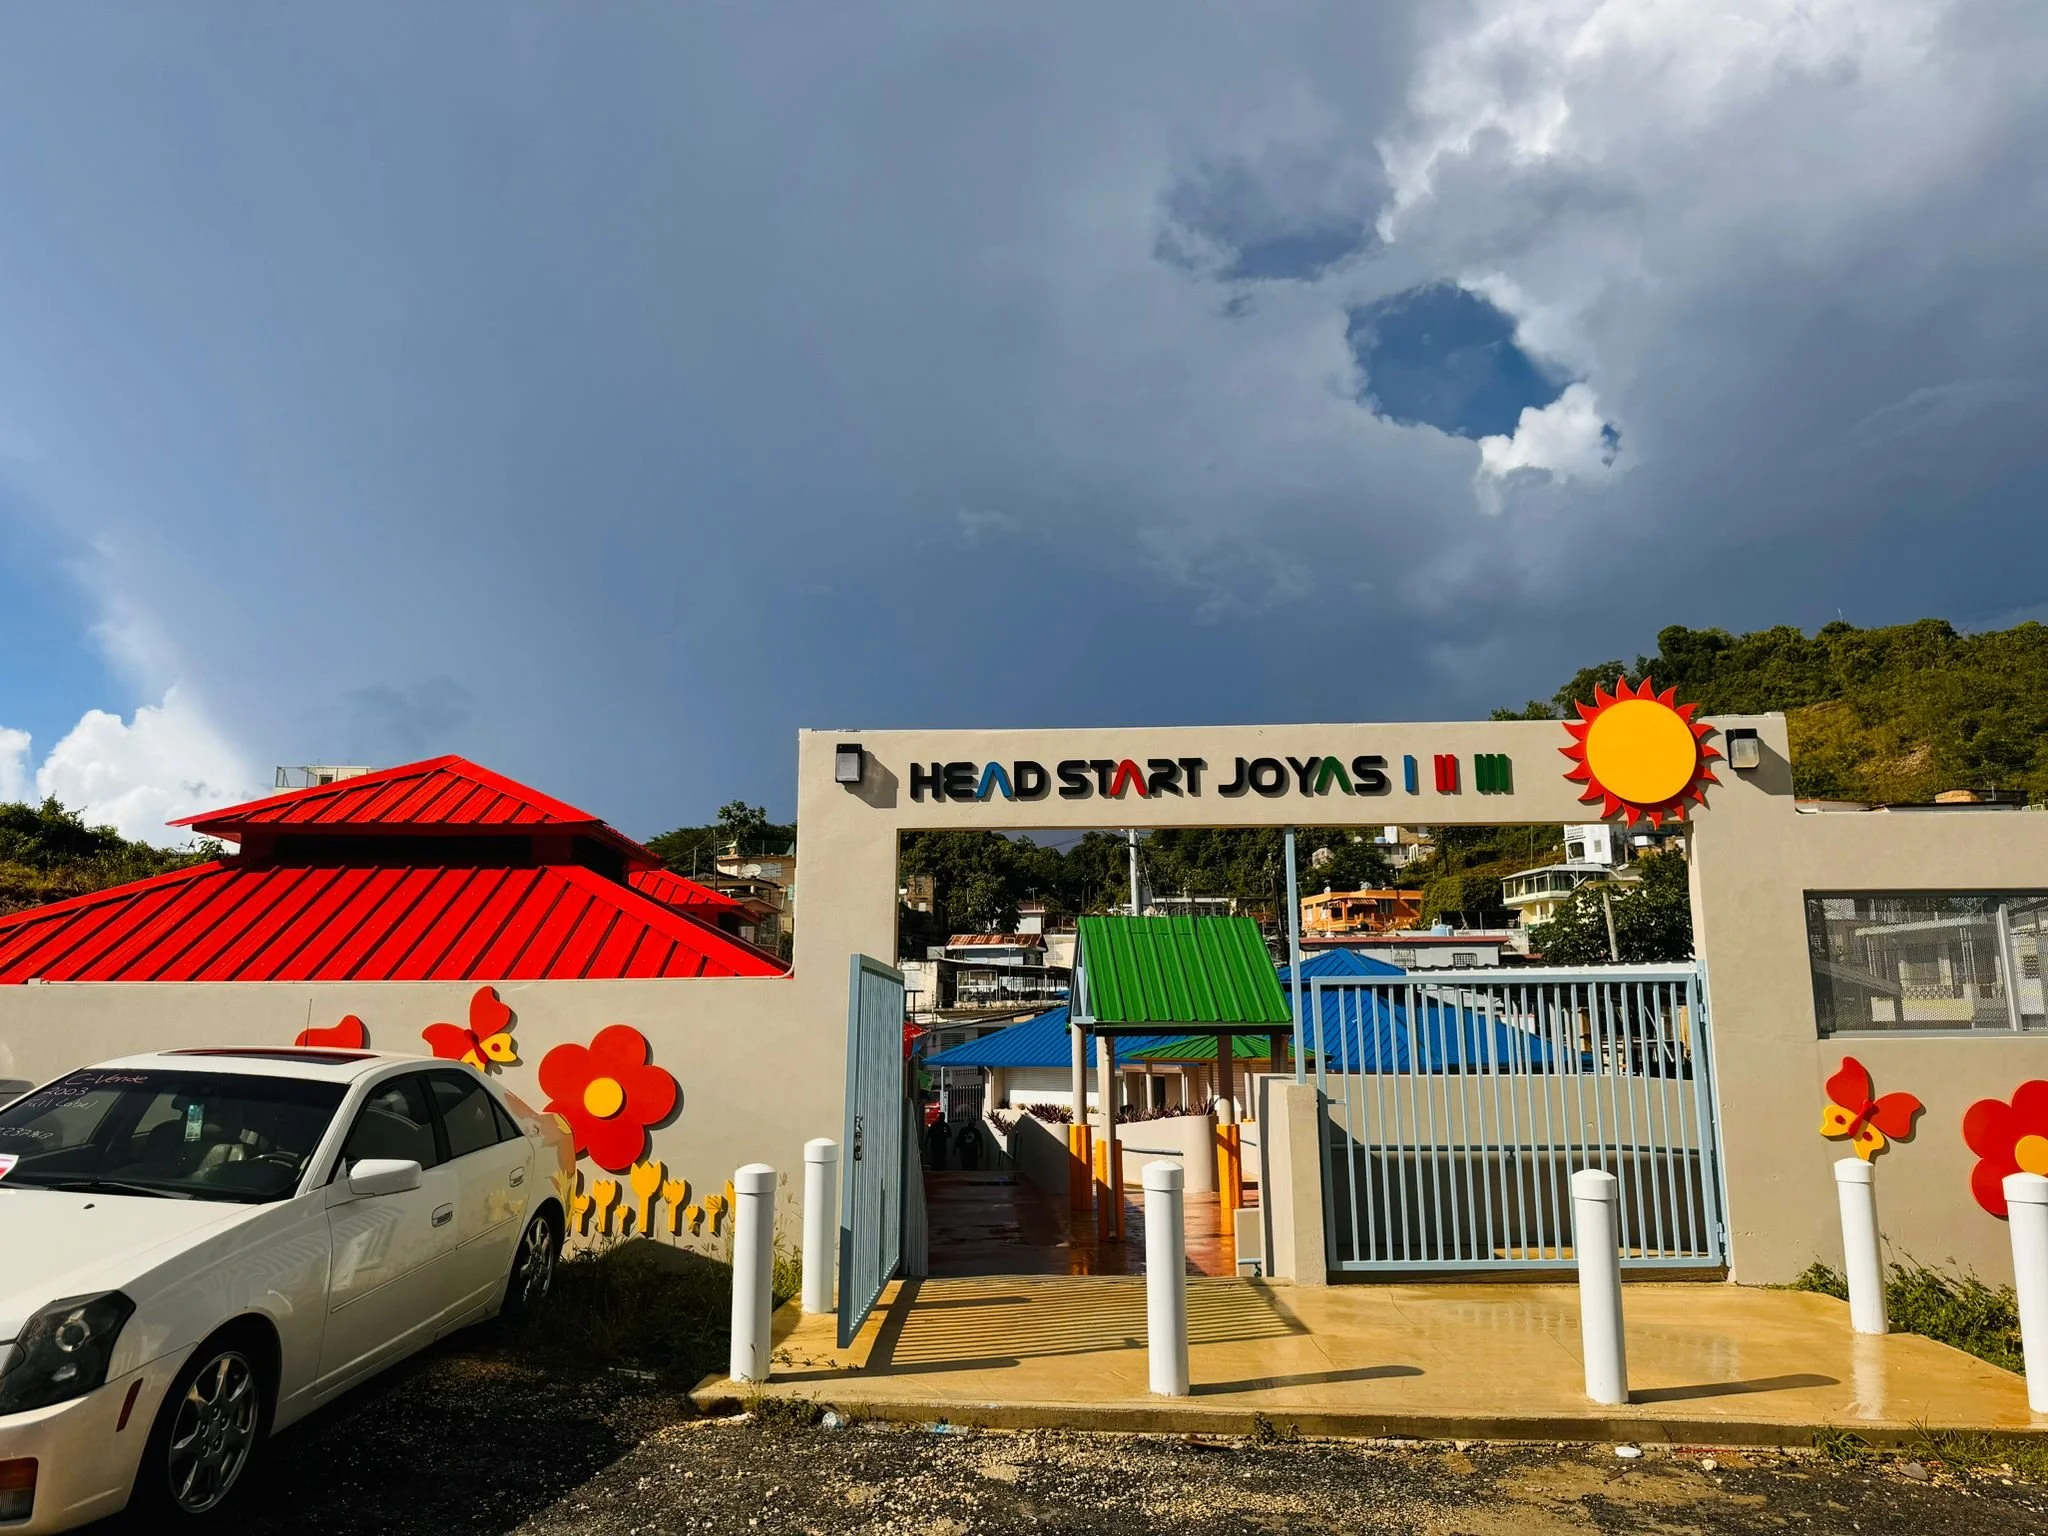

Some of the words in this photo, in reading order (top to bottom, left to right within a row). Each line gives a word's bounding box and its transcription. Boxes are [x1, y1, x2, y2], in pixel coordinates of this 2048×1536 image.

[910, 760, 1048, 799] HEAD
[1057, 758, 1204, 796] START
[1218, 755, 1387, 794] JOYAS
[1404, 754, 1416, 792] I
[1434, 754, 1458, 792] II
[1474, 754, 1510, 792] III
[43, 1087, 89, 1096] 2003
